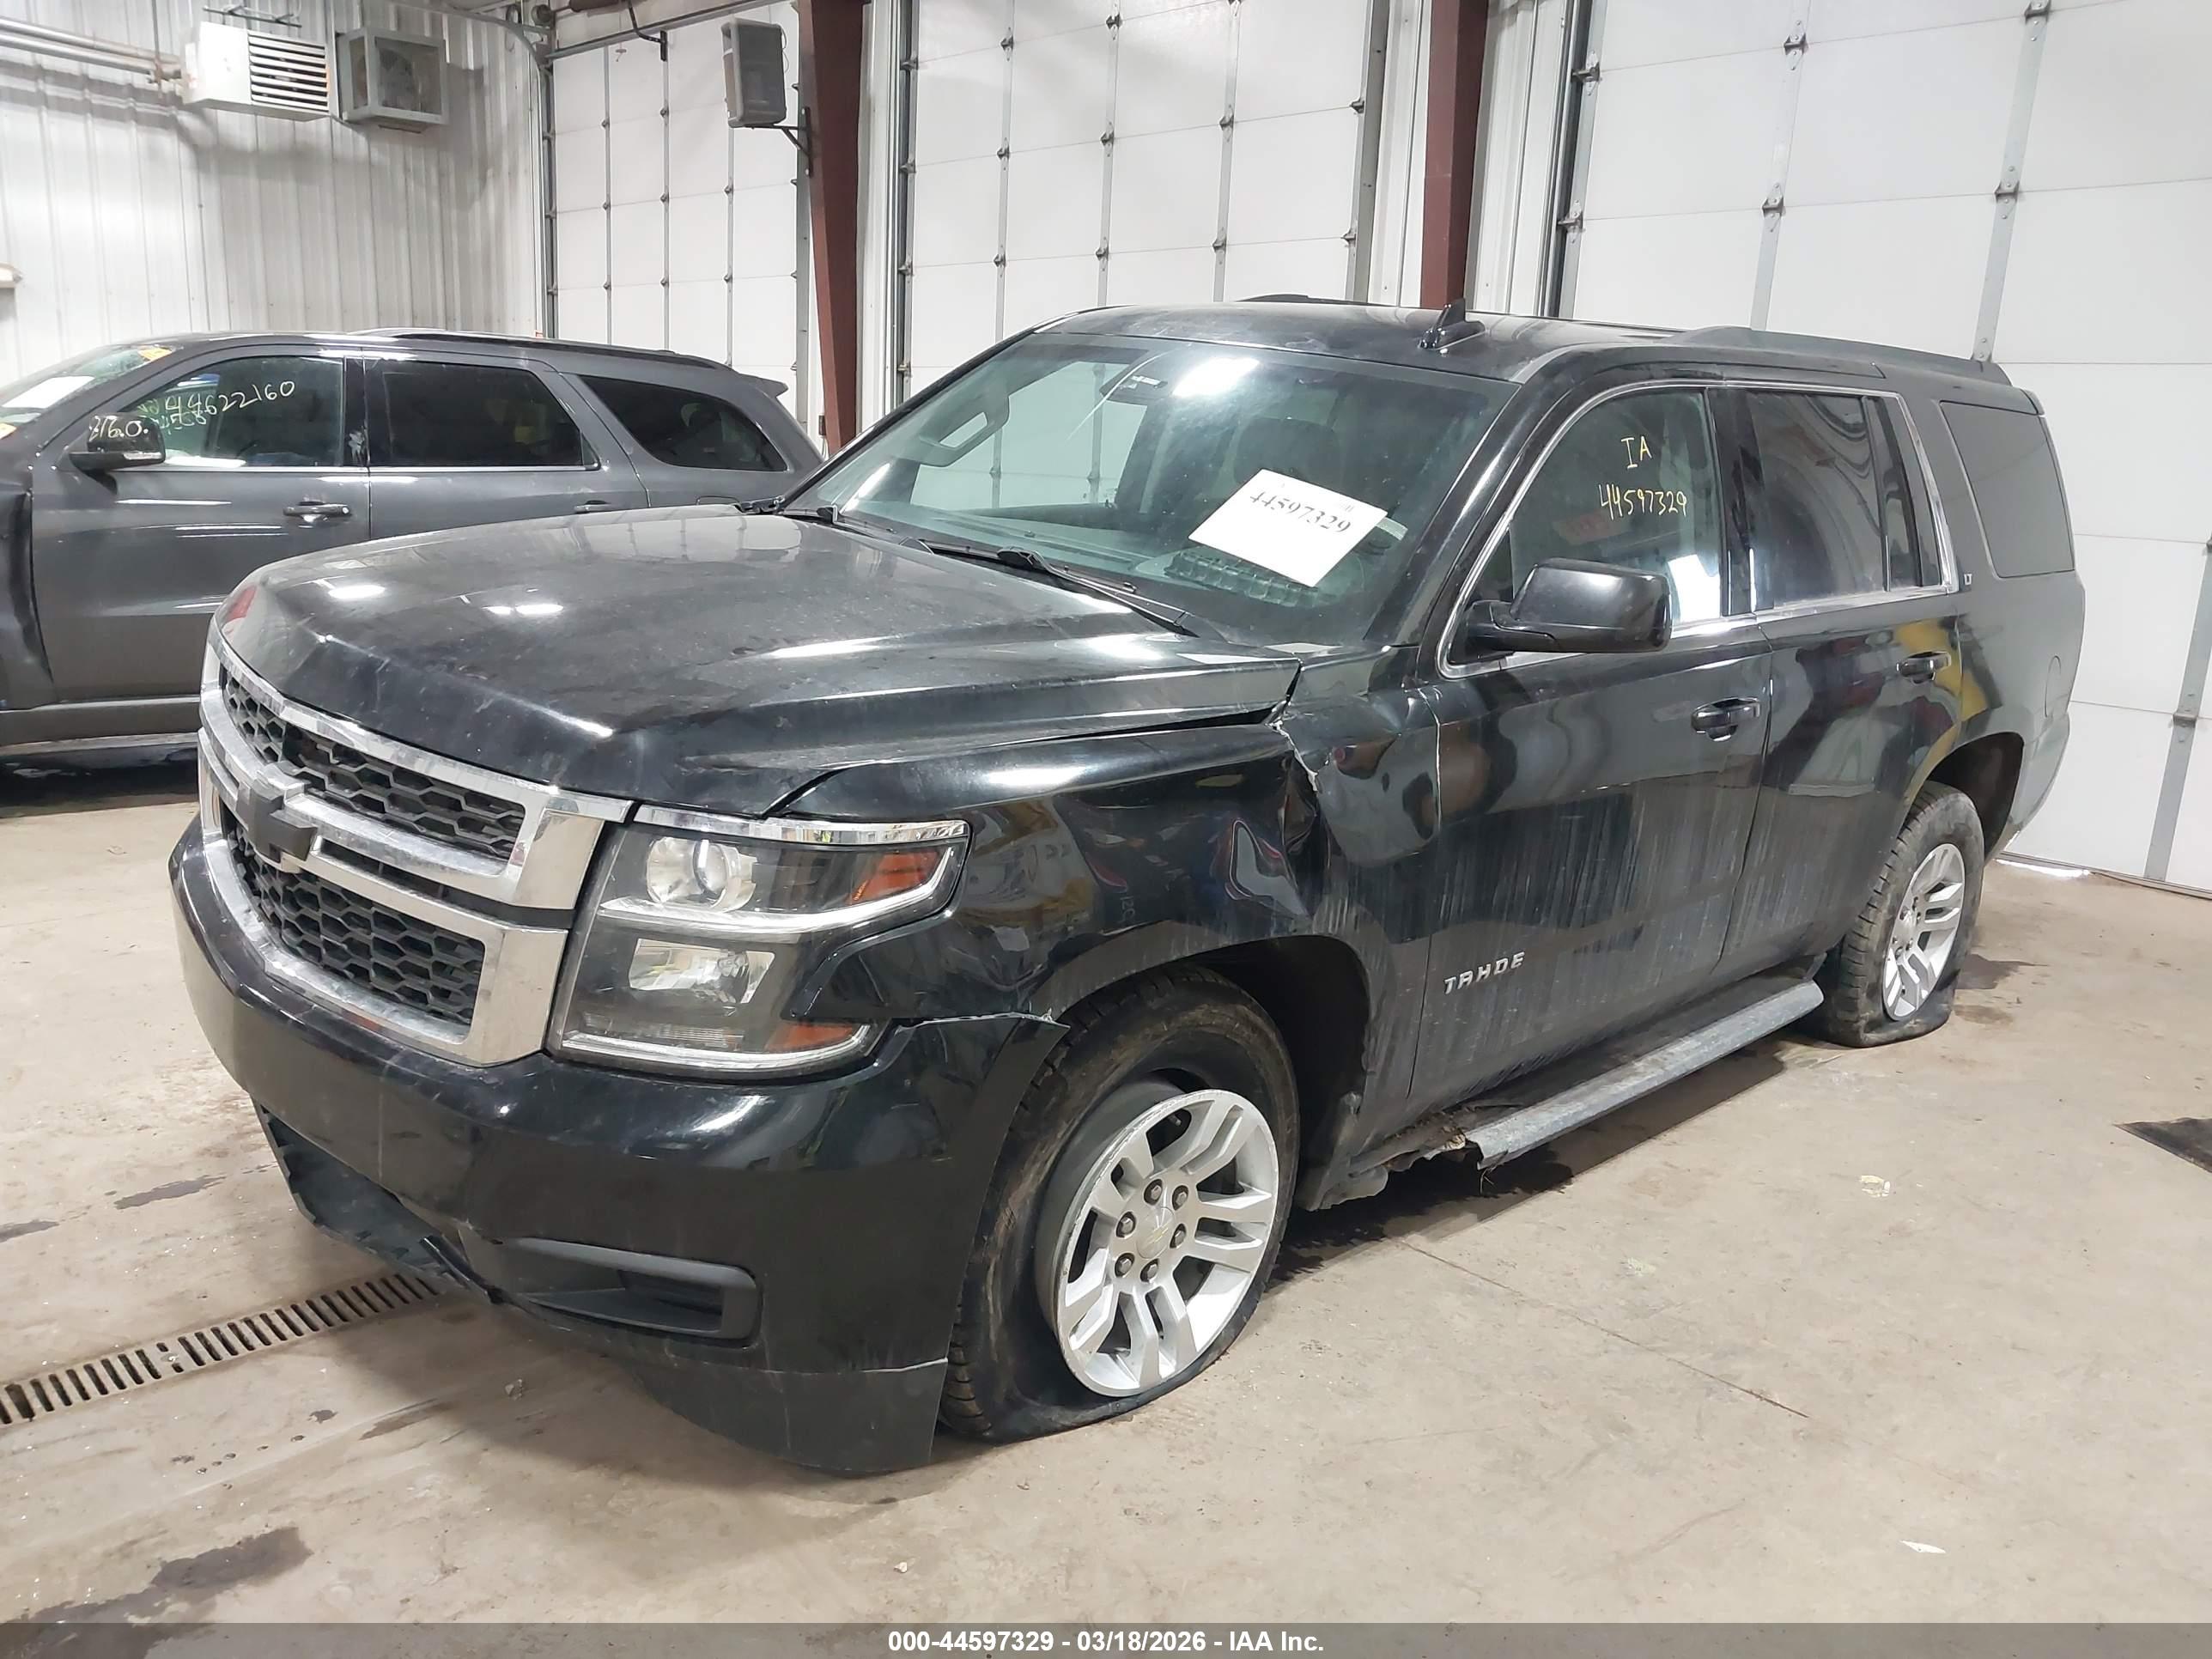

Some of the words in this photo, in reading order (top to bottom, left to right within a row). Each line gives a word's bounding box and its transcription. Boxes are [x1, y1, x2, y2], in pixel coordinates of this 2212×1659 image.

[1250, 490, 1352, 533] 44597329
[1598, 483, 1687, 520] 44597329
[1443, 951, 1525, 994] TAHOE
